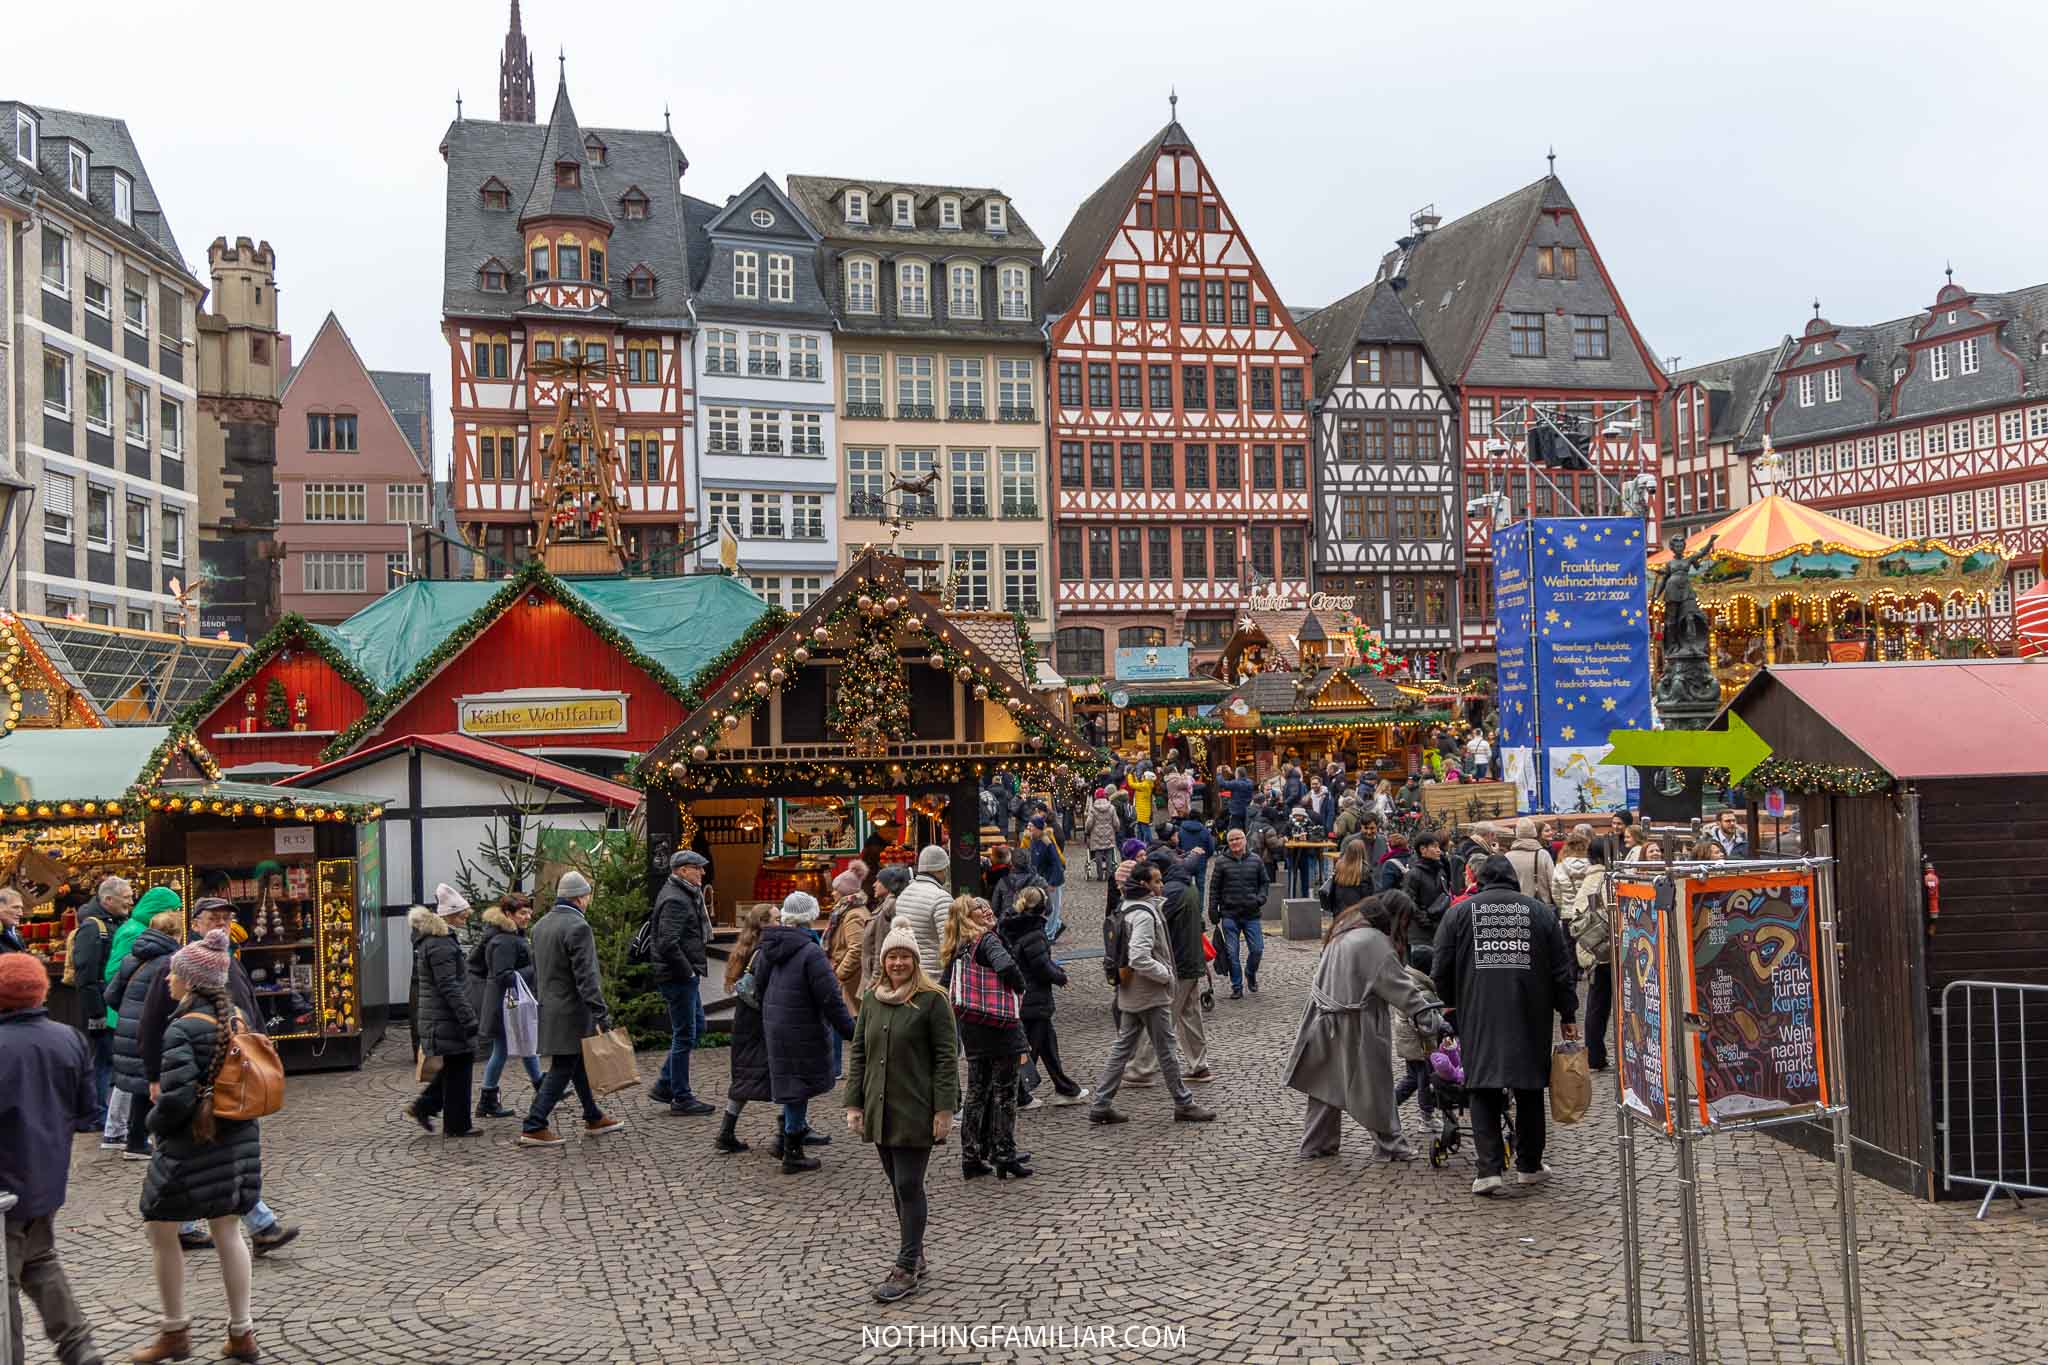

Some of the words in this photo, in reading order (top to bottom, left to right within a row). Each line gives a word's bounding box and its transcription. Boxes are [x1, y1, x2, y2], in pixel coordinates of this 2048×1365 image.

[1560, 560, 1621, 573] Frankfurter
[1542, 573, 1638, 587] Weihnachtsmarkt
[471, 708, 521, 725] Käthe
[528, 705, 616, 723] Wohlfahrt
[1472, 902, 1530, 914] Lacoste
[1472, 914, 1531, 926] Lacoste
[1473, 926, 1531, 938] Lacoste
[1474, 939, 1530, 951] Lacoste
[1475, 951, 1531, 964] Lacoste
[1771, 957, 1809, 982] Frank
[1773, 980, 1811, 998] furter
[1779, 1024, 1812, 1043] Weih
[1771, 1040, 1813, 1060] nachts
[1775, 1056, 1813, 1075] markt
